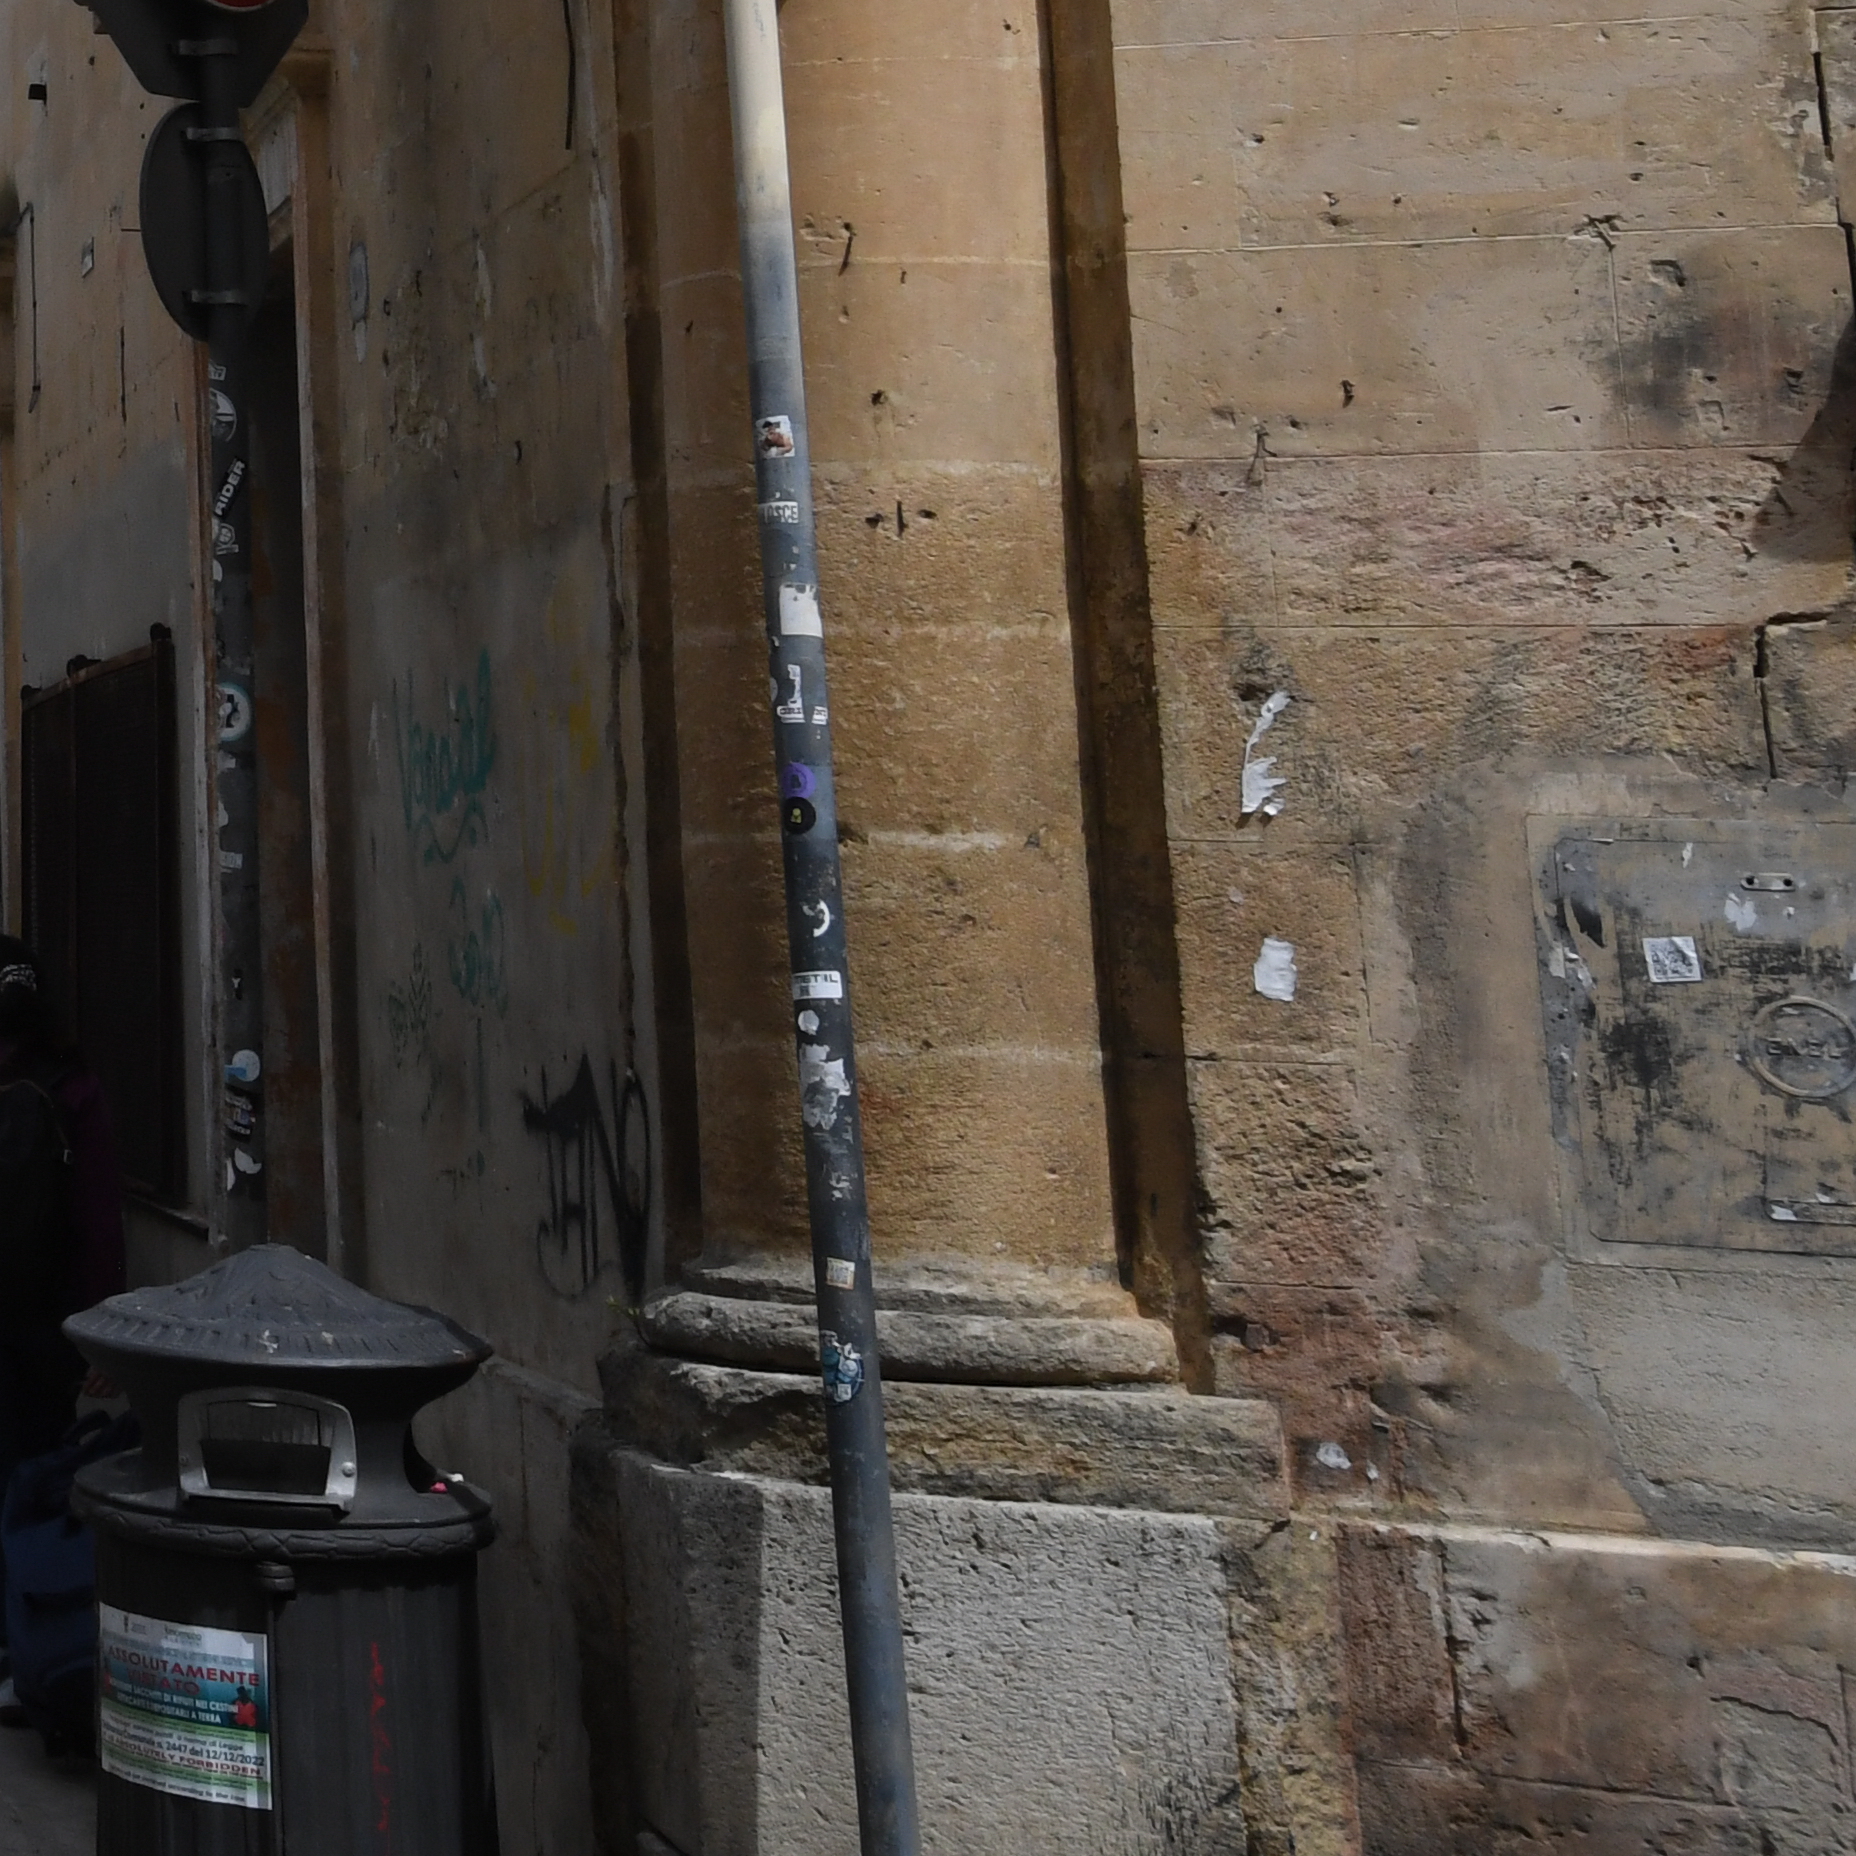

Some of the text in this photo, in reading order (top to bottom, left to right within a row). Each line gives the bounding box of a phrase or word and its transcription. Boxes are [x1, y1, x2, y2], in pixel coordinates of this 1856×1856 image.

[214, 460, 246, 517] RIDER
[108, 1645, 261, 1687] ASSOLUTAMENTE
[126, 1666, 201, 1695] VIETATO
[165, 1740, 188, 1753] 2447
[189, 1745, 204, 1757] del
[205, 1749, 265, 1767] 12/12/2022
[218, 1740, 244, 1752] Legge
[179, 1755, 262, 1776] FORBIDDEN
